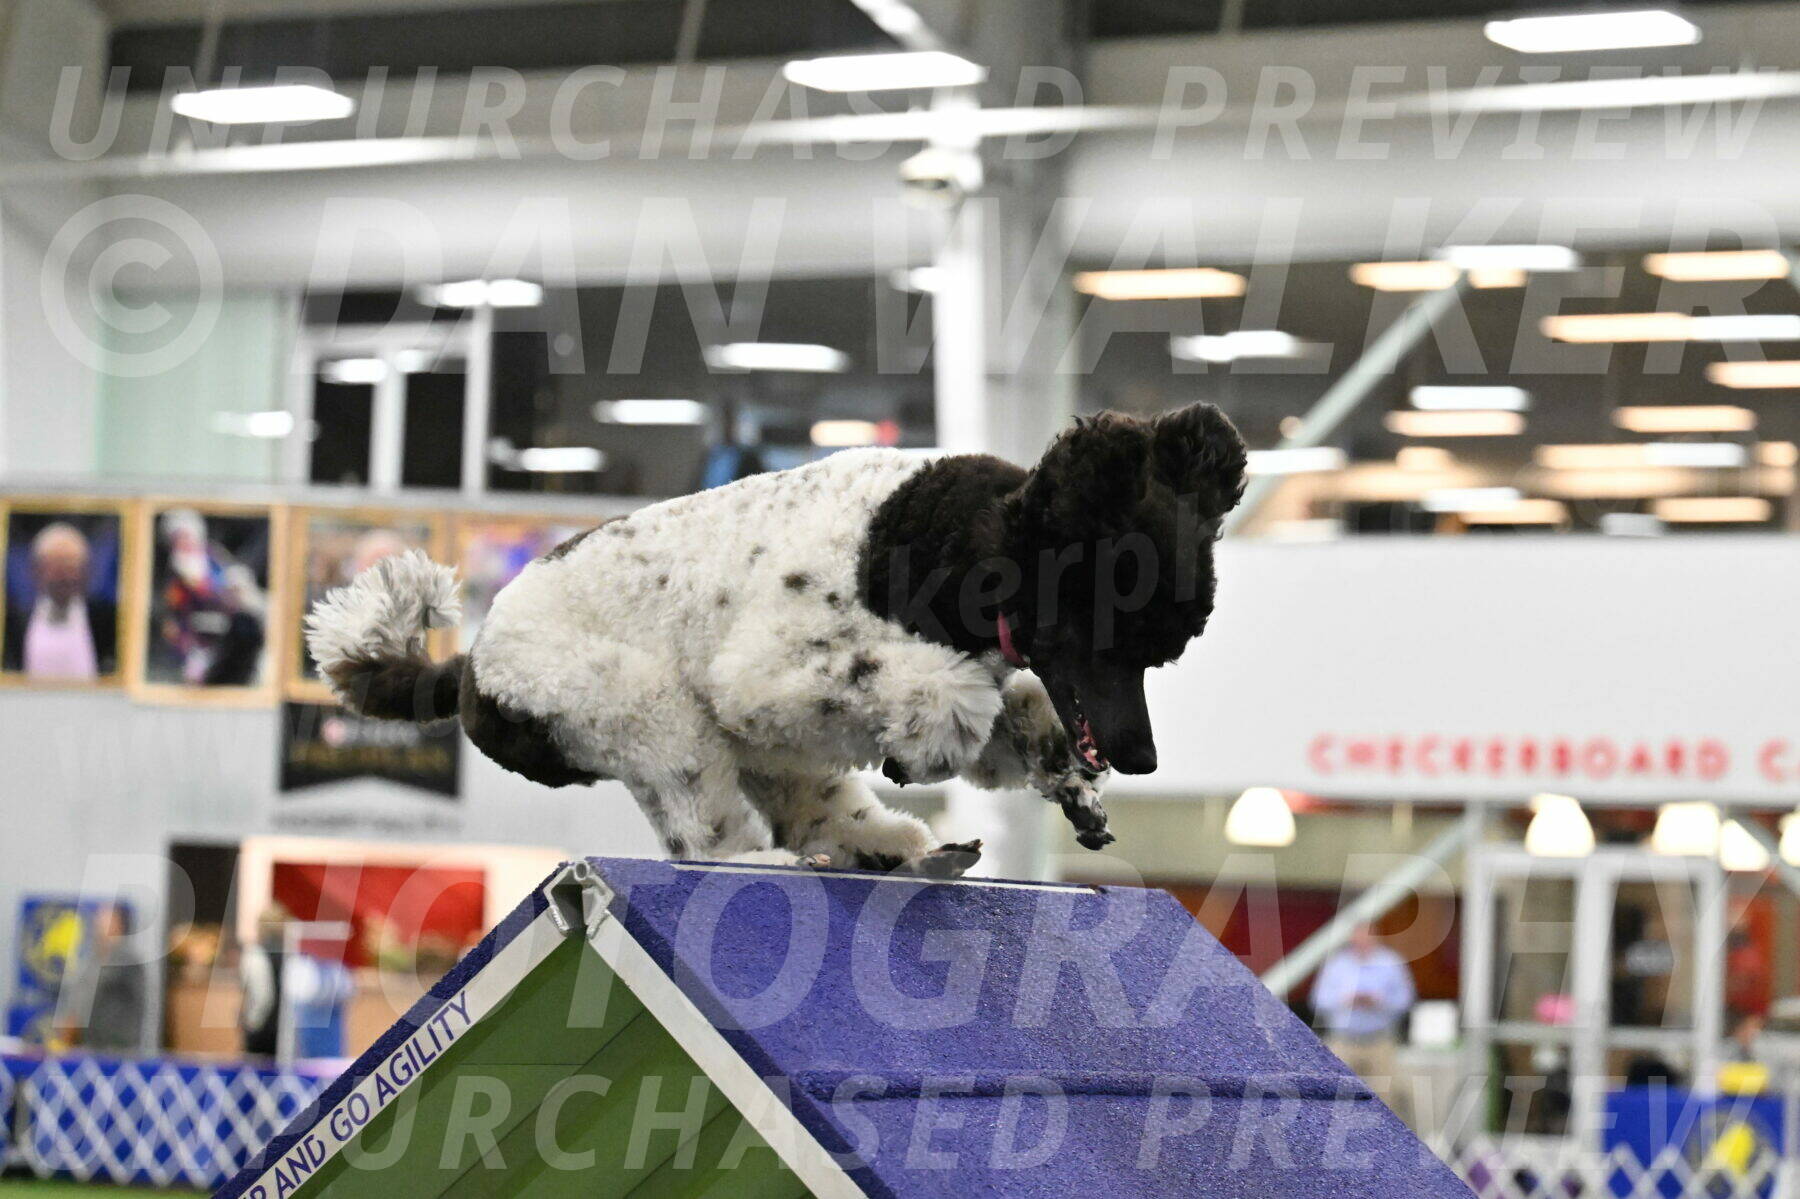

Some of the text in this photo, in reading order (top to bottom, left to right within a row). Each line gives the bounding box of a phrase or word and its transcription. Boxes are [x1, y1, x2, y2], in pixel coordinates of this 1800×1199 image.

[1307, 734, 1729, 782] CHECKERBOARD
[274, 1134, 326, 1199] AND
[330, 1092, 370, 1142] GO
[374, 990, 472, 1107] AGILITY
